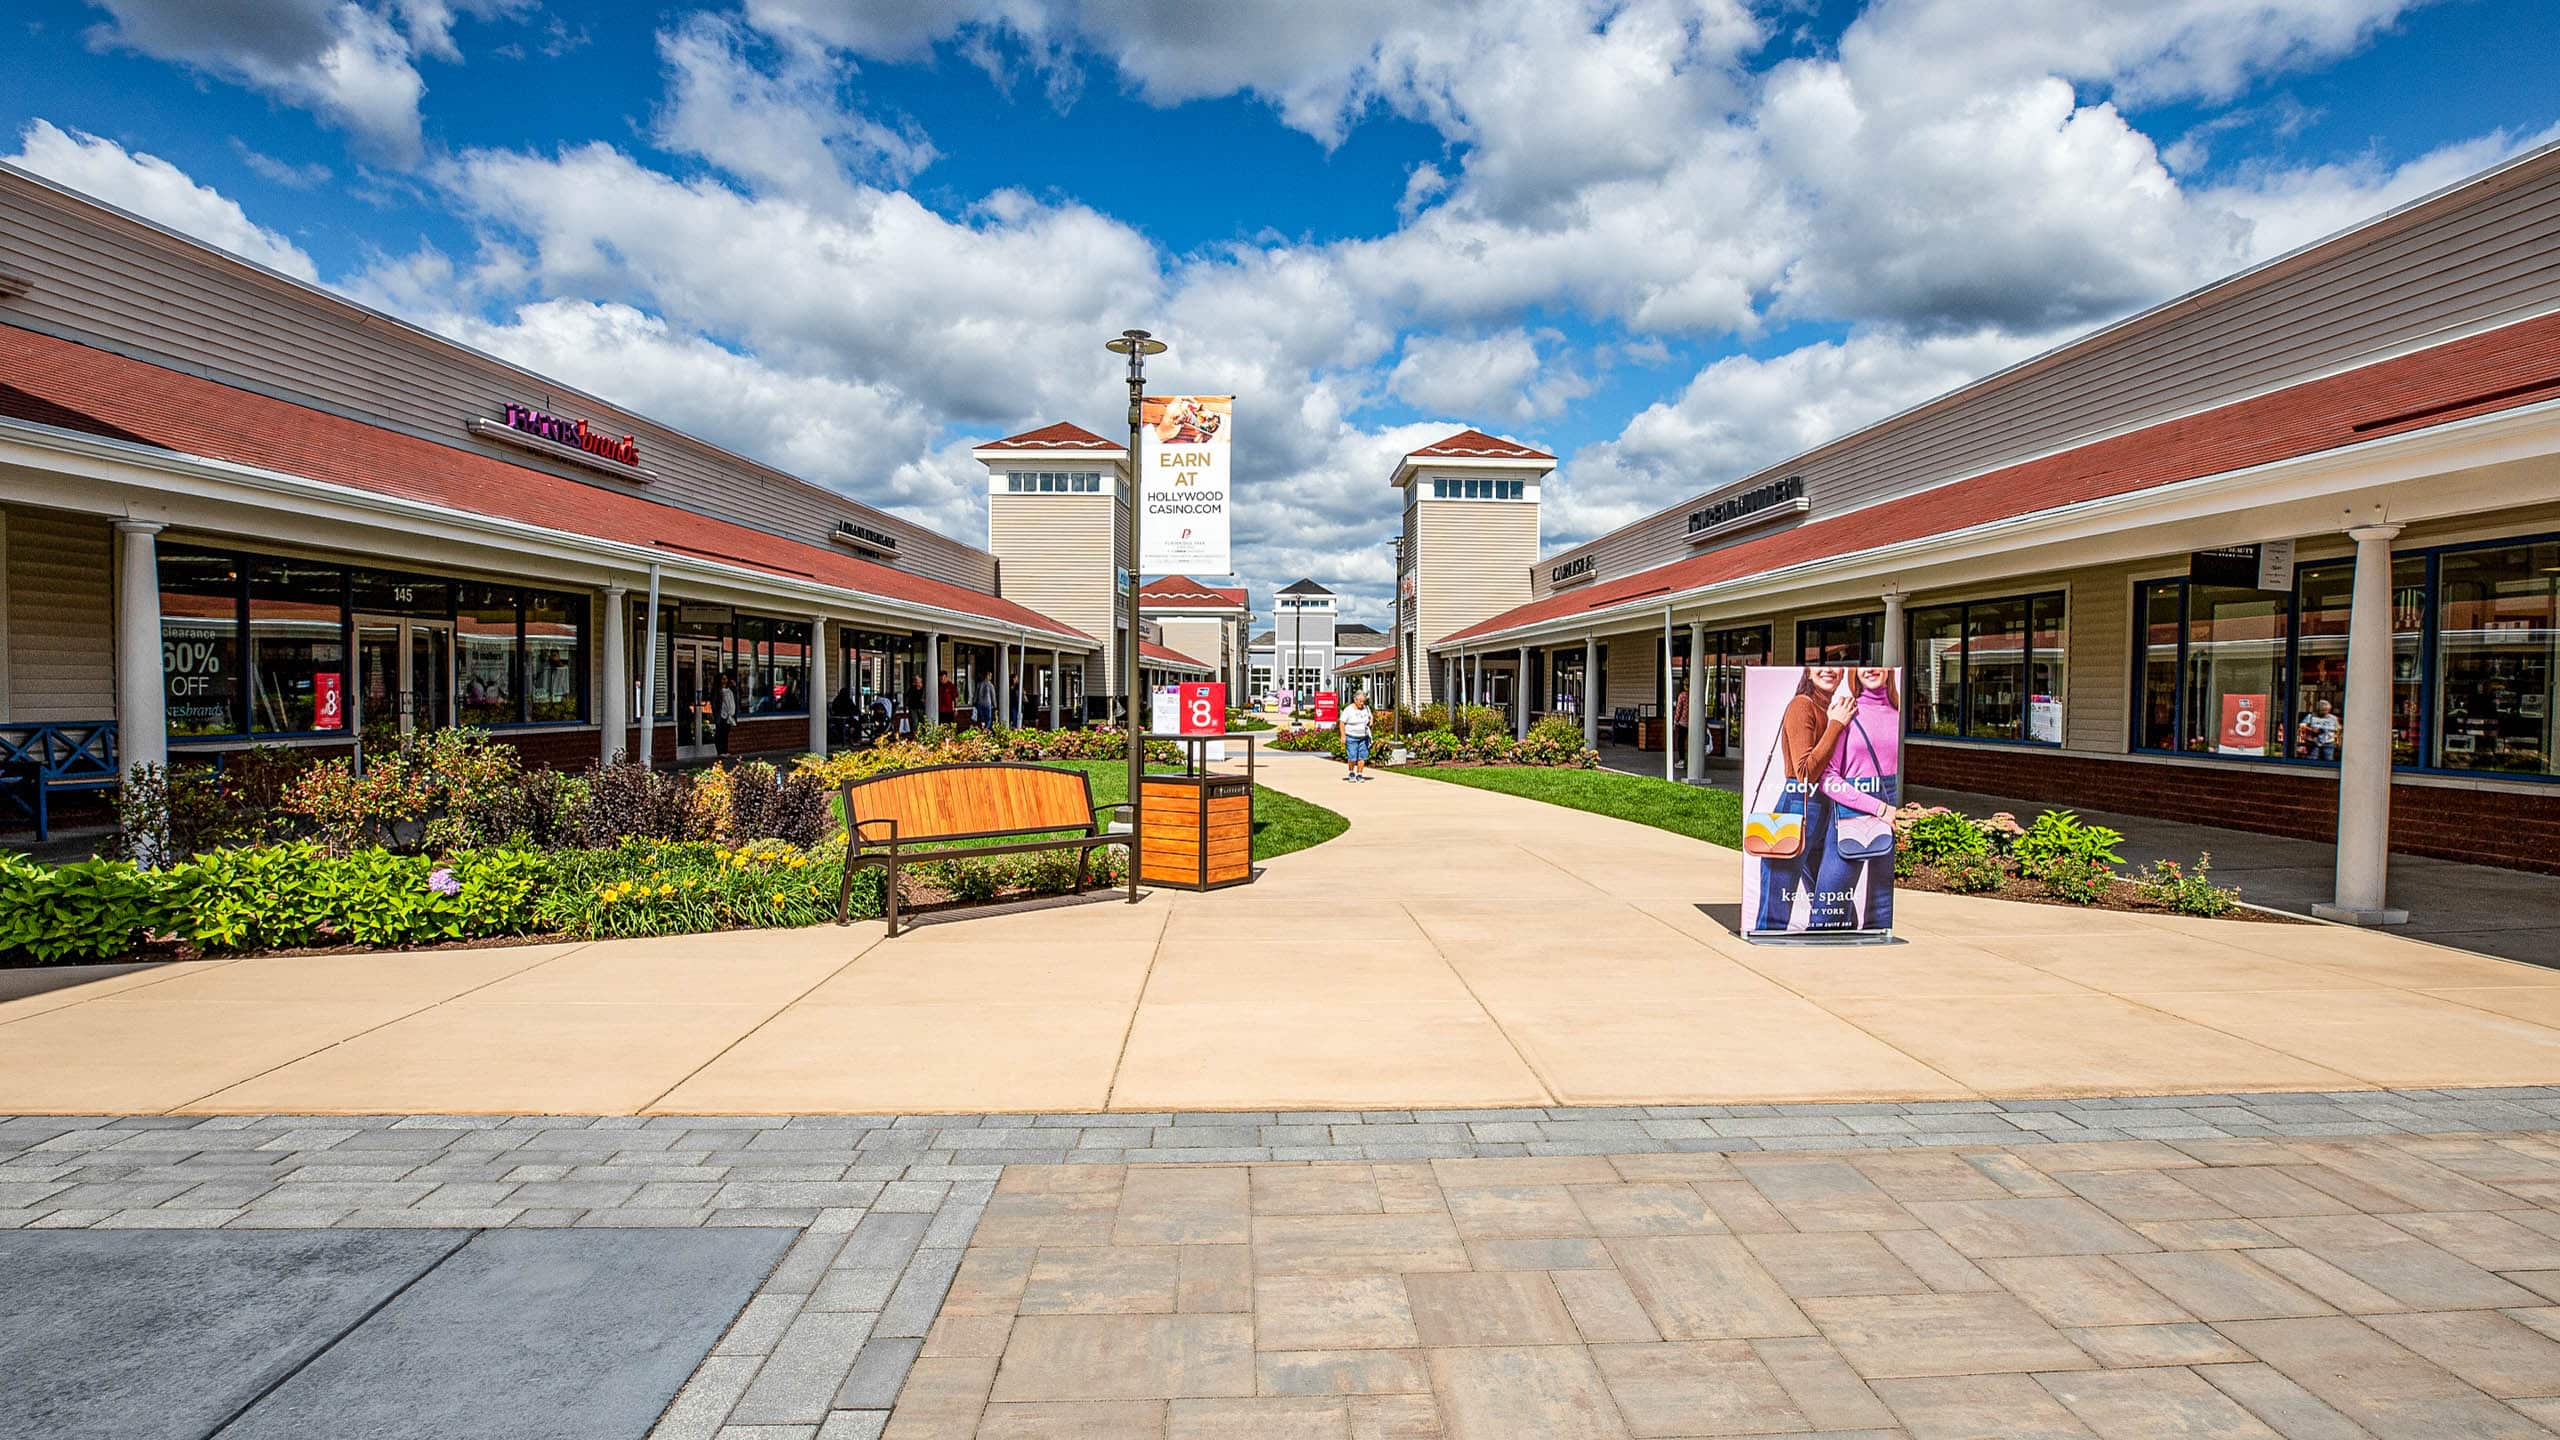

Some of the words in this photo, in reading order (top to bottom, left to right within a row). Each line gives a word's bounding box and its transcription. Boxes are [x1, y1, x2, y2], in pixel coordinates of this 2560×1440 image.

[1160, 453, 1211, 467] EARN
[1175, 472, 1198, 486] AT
[1147, 491, 1224, 502] HOLLYWOOD
[1149, 504, 1222, 514] CASINO.COM
[394, 587, 413, 602] 145
[162, 627, 216, 639] clearance
[162, 642, 219, 674] 60%
[171, 676, 210, 696] OFF
[1768, 777, 1819, 798] ady
[1824, 777, 1847, 793] for
[1854, 776, 1880, 793] fall
[1781, 888, 1815, 902] kae
[1819, 888, 1858, 905] spad
[1821, 908, 1845, 916] YORK
